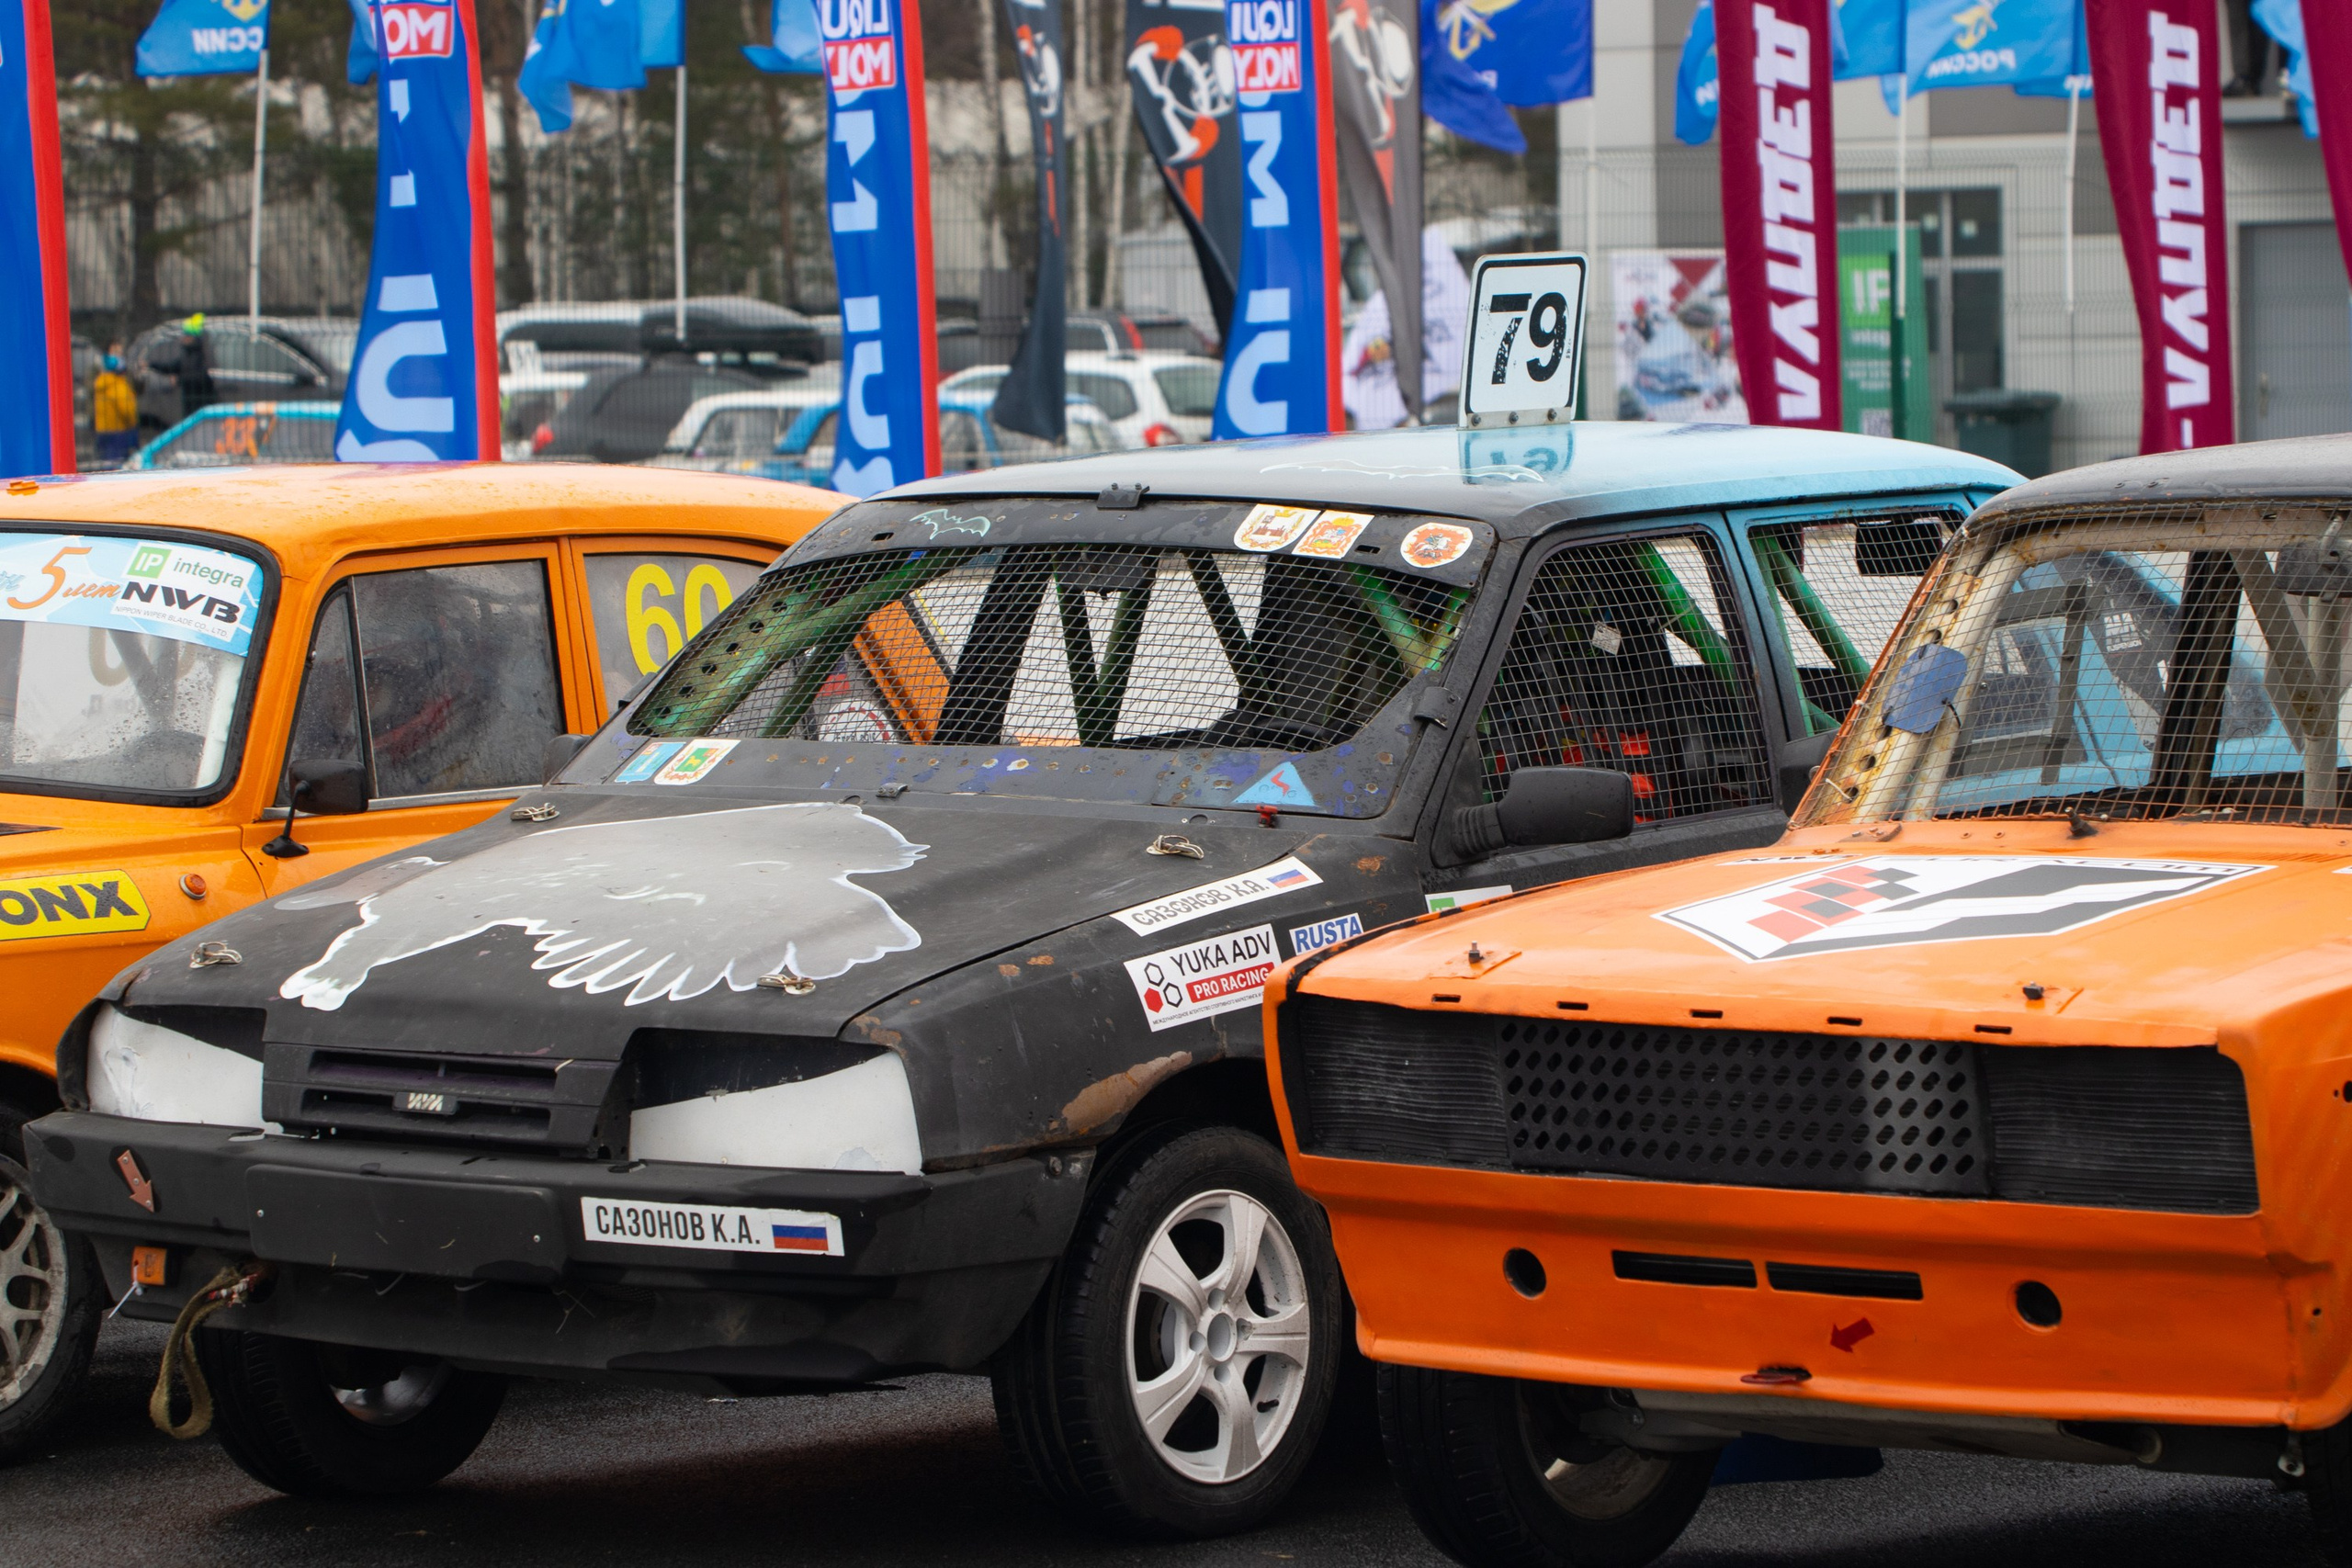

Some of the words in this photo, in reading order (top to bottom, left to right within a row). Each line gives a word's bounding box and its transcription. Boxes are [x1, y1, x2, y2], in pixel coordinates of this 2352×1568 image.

[1489, 291, 1568, 385] 79
[6, 547, 93, 610] 5
[133, 552, 164, 572] IP
[173, 558, 245, 589] integra
[121, 581, 241, 624] NWB
[115, 605, 142, 615] NIPPON
[143, 609, 166, 619] WIPER
[167, 615, 194, 626] BLADE
[211, 626, 229, 638] LTD.
[1131, 889, 1232, 926] САЗОНОВ
[1295, 916, 1363, 953] RUSTA
[1170, 943, 1228, 976] YUKA
[1232, 931, 1271, 964] ADV
[1193, 982, 1220, 999] PRO
[1222, 966, 1270, 993] RACING
[595, 1205, 705, 1241] САЗОНОВ
[711, 1213, 761, 1245] К.А.
